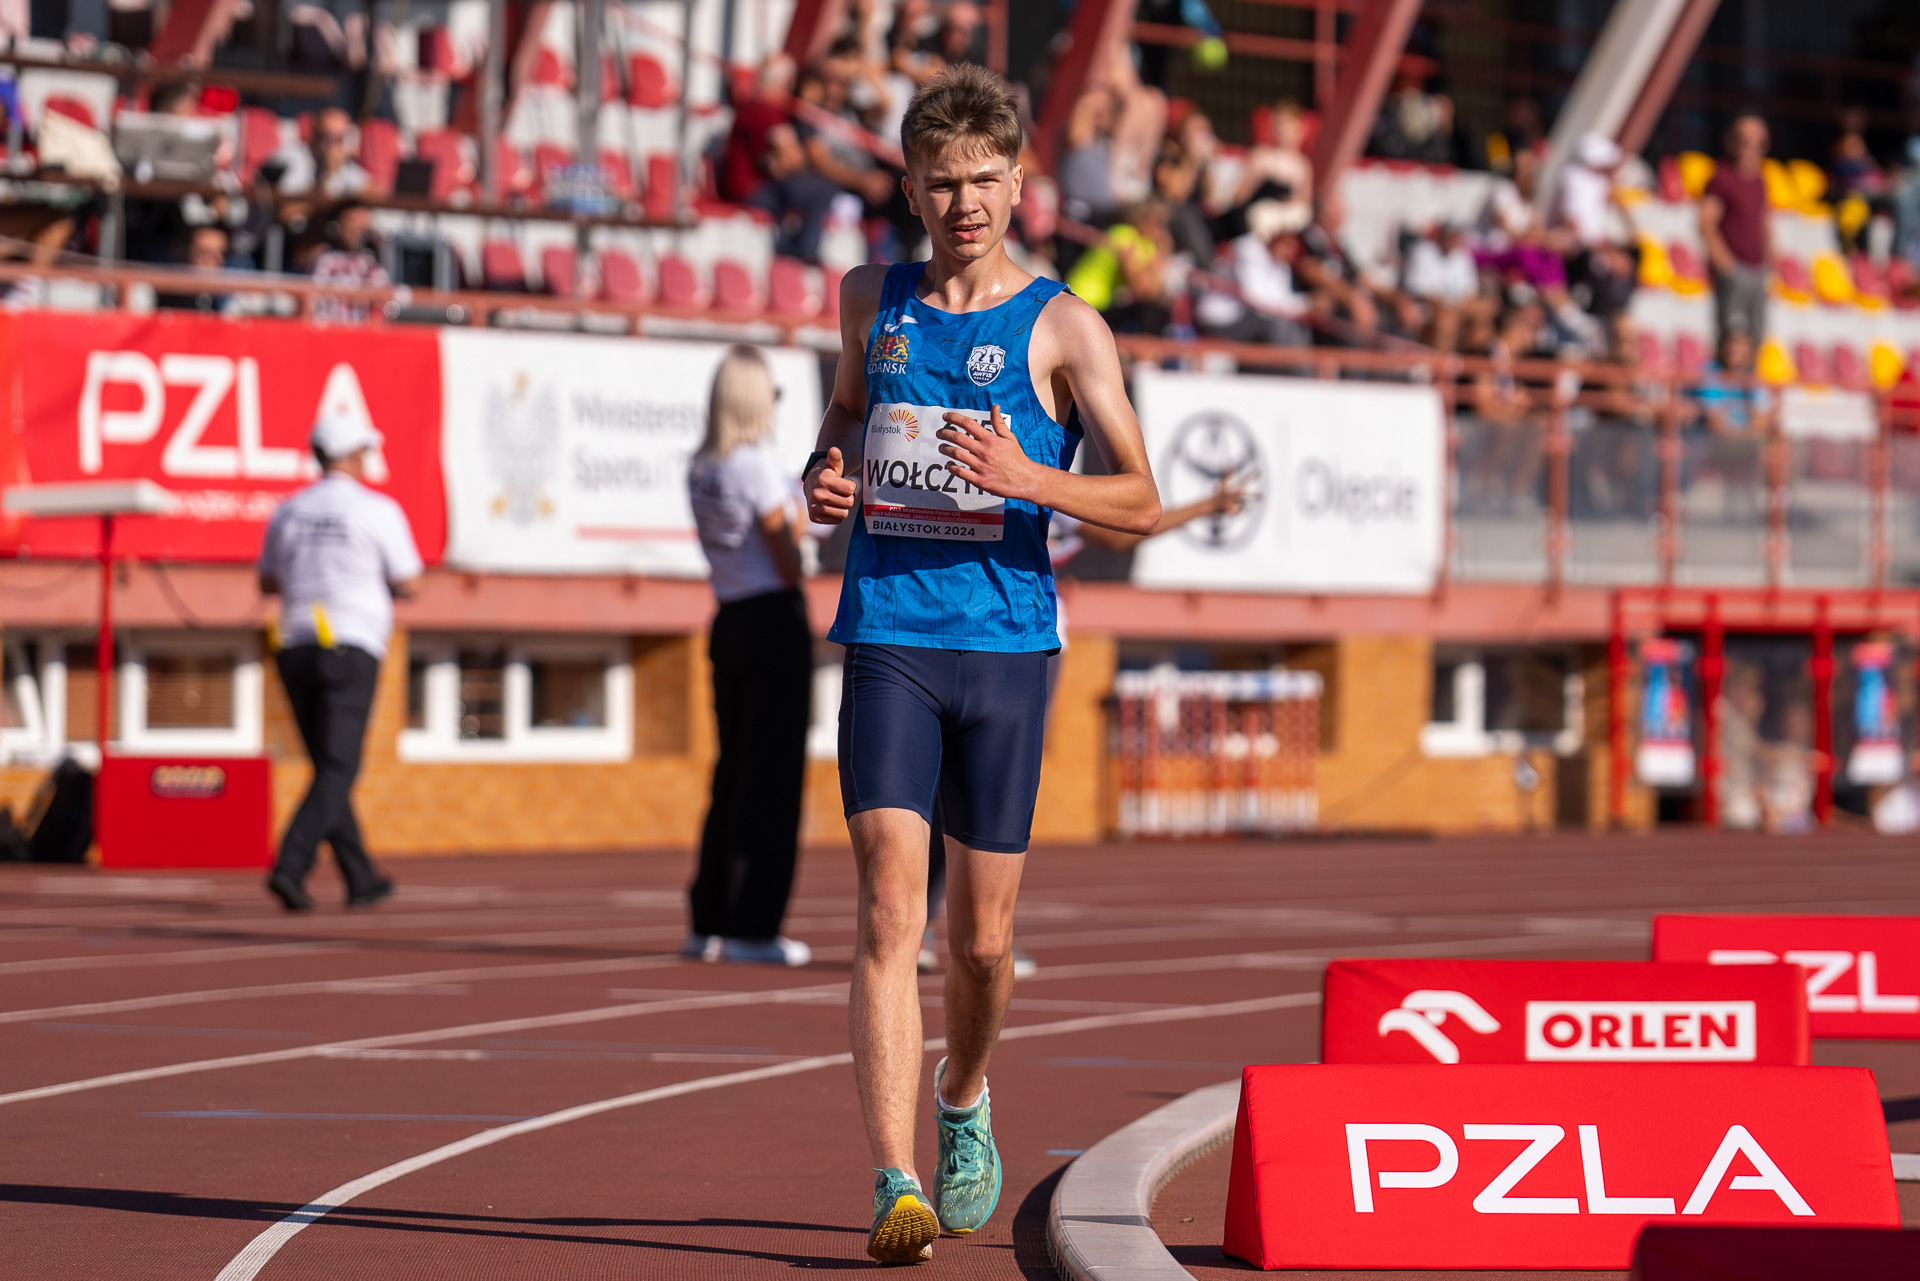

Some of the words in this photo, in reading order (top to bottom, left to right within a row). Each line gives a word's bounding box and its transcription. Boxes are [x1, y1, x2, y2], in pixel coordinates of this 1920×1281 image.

[867, 361, 907, 375] GDAŃSK
[78, 349, 390, 485] PZLA
[871, 424, 902, 436] Białystok
[872, 520, 942, 535] BIAŁYSTOK
[944, 525, 976, 537] 2024
[1541, 1012, 1739, 1050] ORLEN
[1344, 1123, 1817, 1216] PZLA
